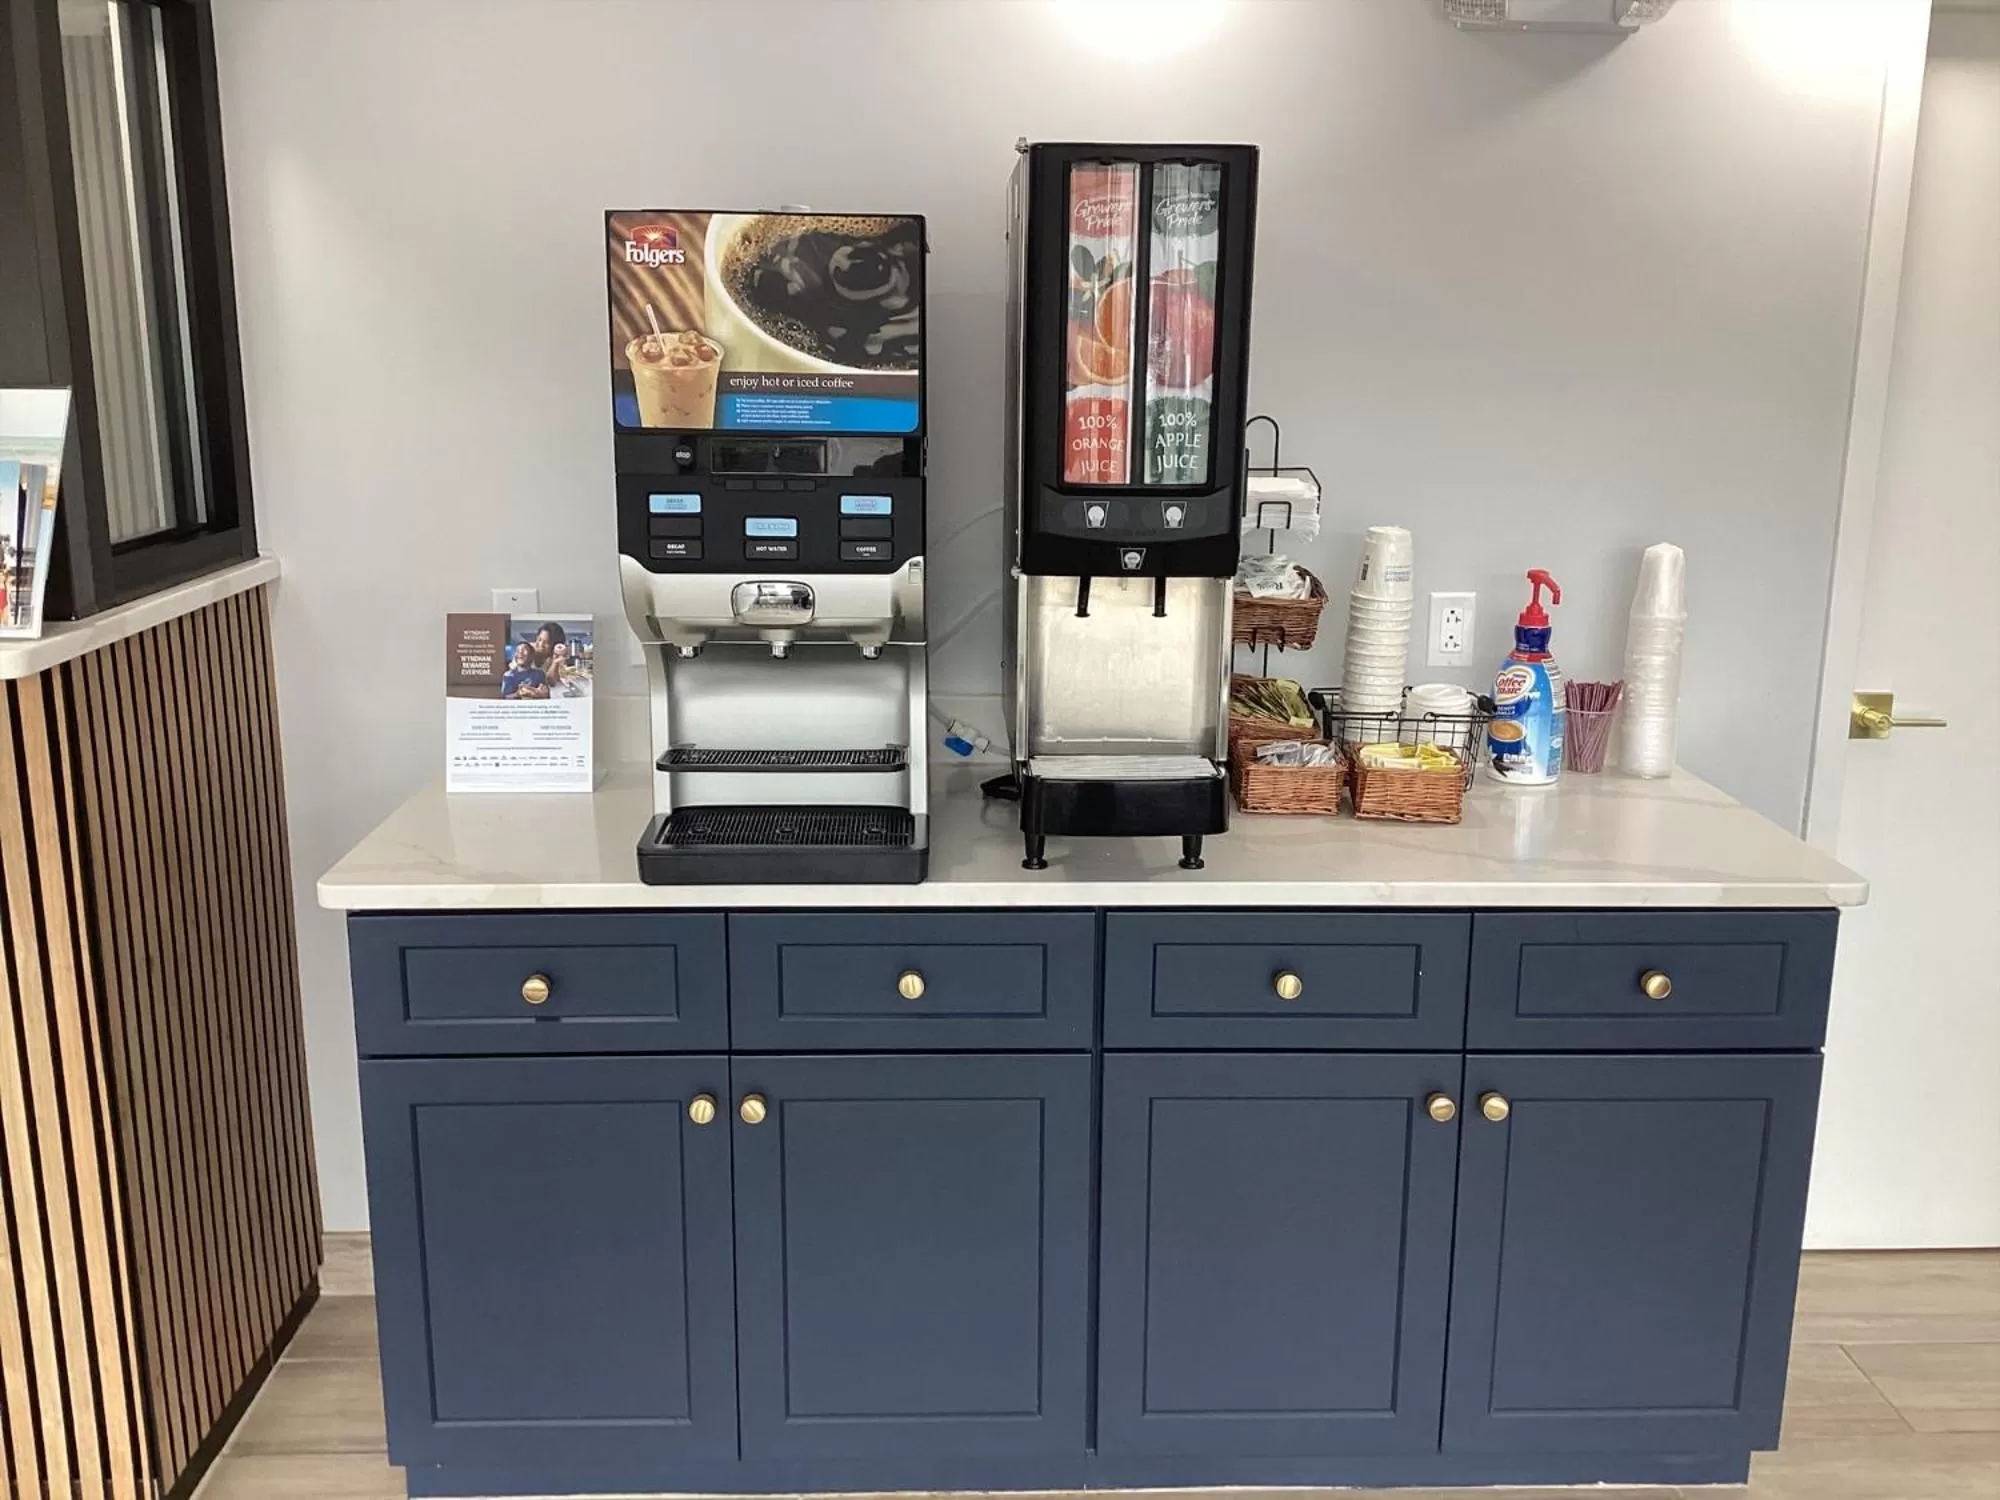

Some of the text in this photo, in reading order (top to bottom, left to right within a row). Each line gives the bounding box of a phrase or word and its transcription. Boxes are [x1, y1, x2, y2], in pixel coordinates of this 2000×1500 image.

[625, 240, 686, 269] Folgers
[729, 375, 855, 390] enjoy hot or iced coffee
[1078, 416, 1118, 430] 100%
[1159, 412, 1198, 428] 100%
[1072, 438, 1125, 452] ORANGE
[1155, 433, 1203, 449] APPLE
[1080, 460, 1119, 476] JUICE
[1156, 454, 1200, 473] JUICE
